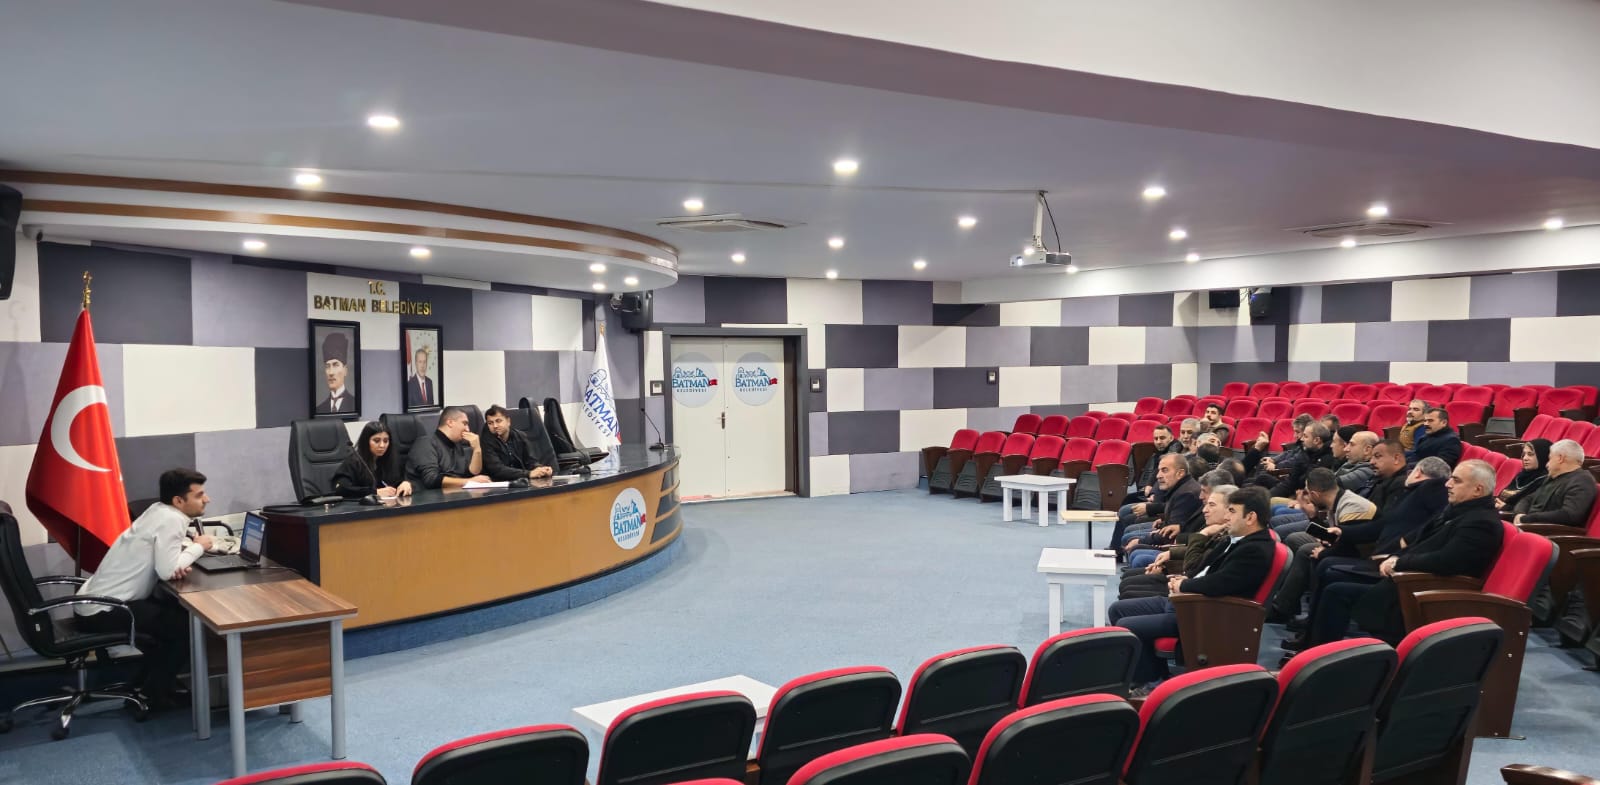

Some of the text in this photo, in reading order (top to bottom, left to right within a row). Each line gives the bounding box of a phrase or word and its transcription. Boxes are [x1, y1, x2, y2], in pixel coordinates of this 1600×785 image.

[313, 295, 366, 312] BATMAN
[672, 378, 709, 388] BATMAN
[735, 378, 771, 388] BATMAN
[584, 389, 619, 437] ATMAN
[613, 515, 642, 536] BATMAN
